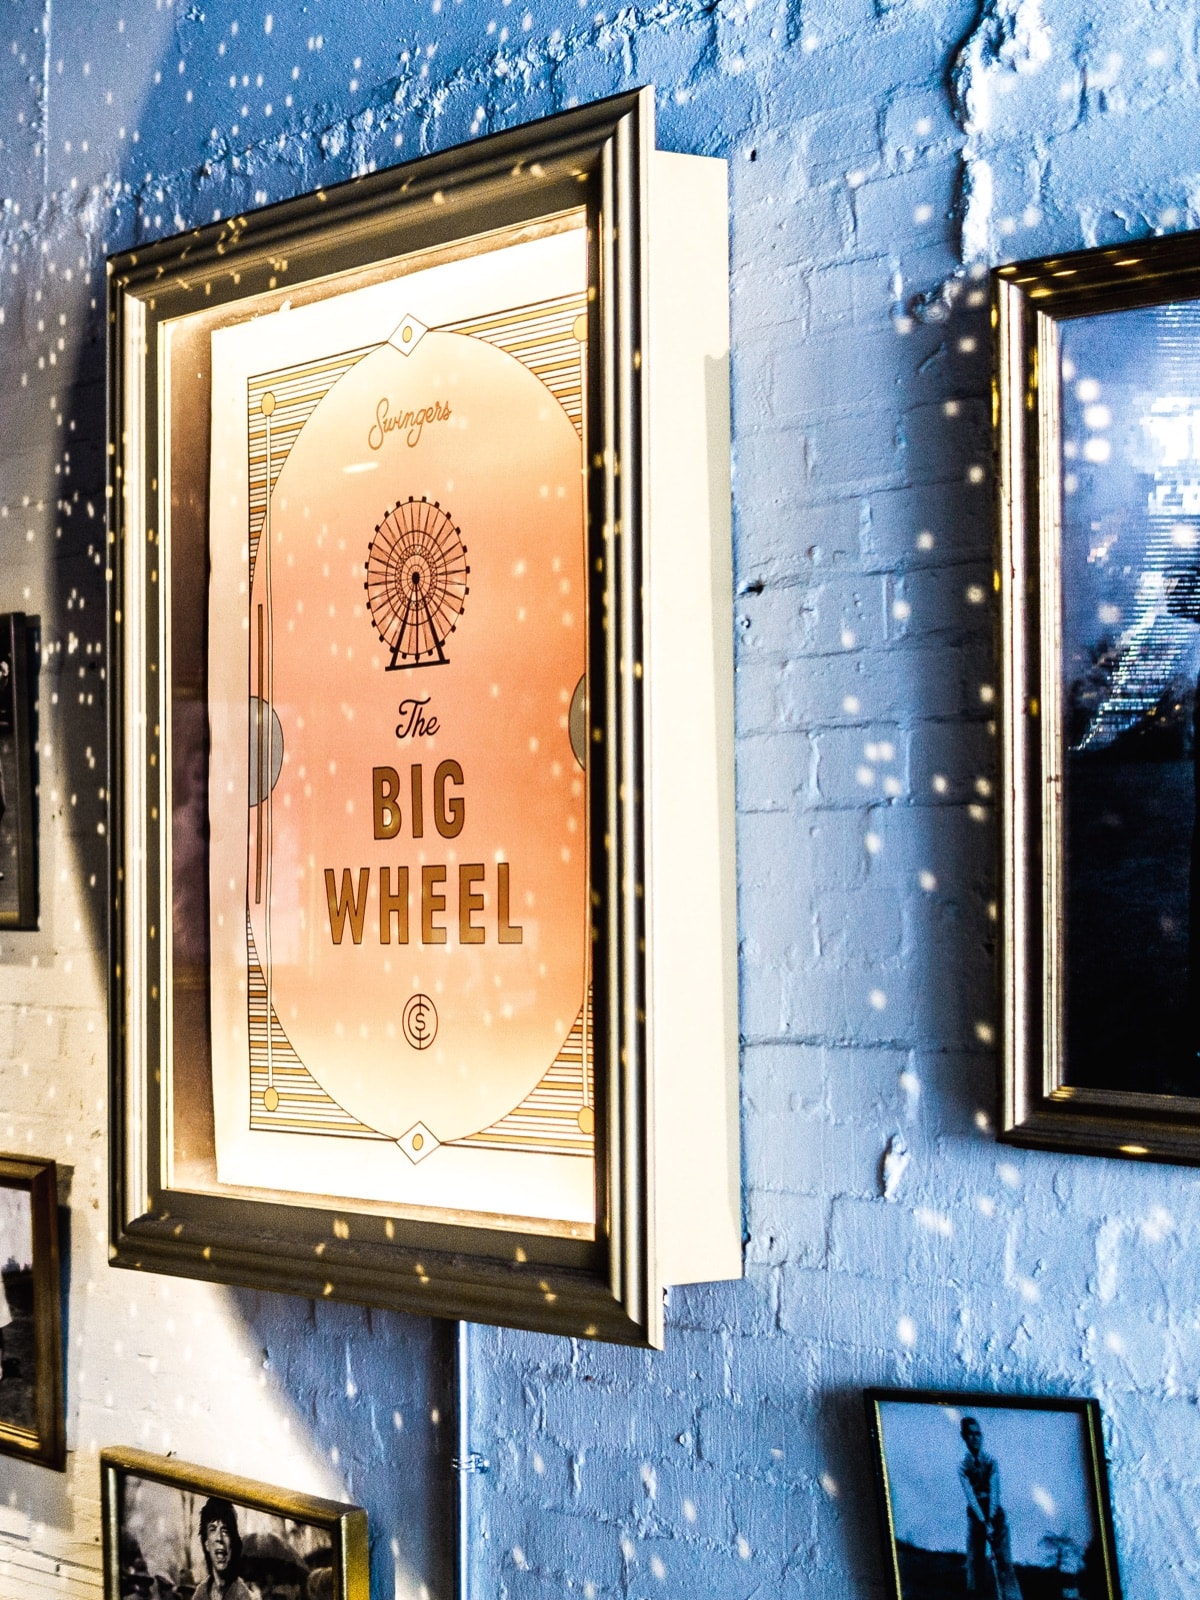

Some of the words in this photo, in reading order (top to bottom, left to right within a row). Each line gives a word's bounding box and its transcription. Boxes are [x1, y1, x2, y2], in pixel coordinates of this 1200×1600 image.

[368, 397, 452, 450] Swingers
[395, 697, 441, 739] The
[372, 759, 465, 840] BIG
[324, 862, 523, 945] WHEEL
